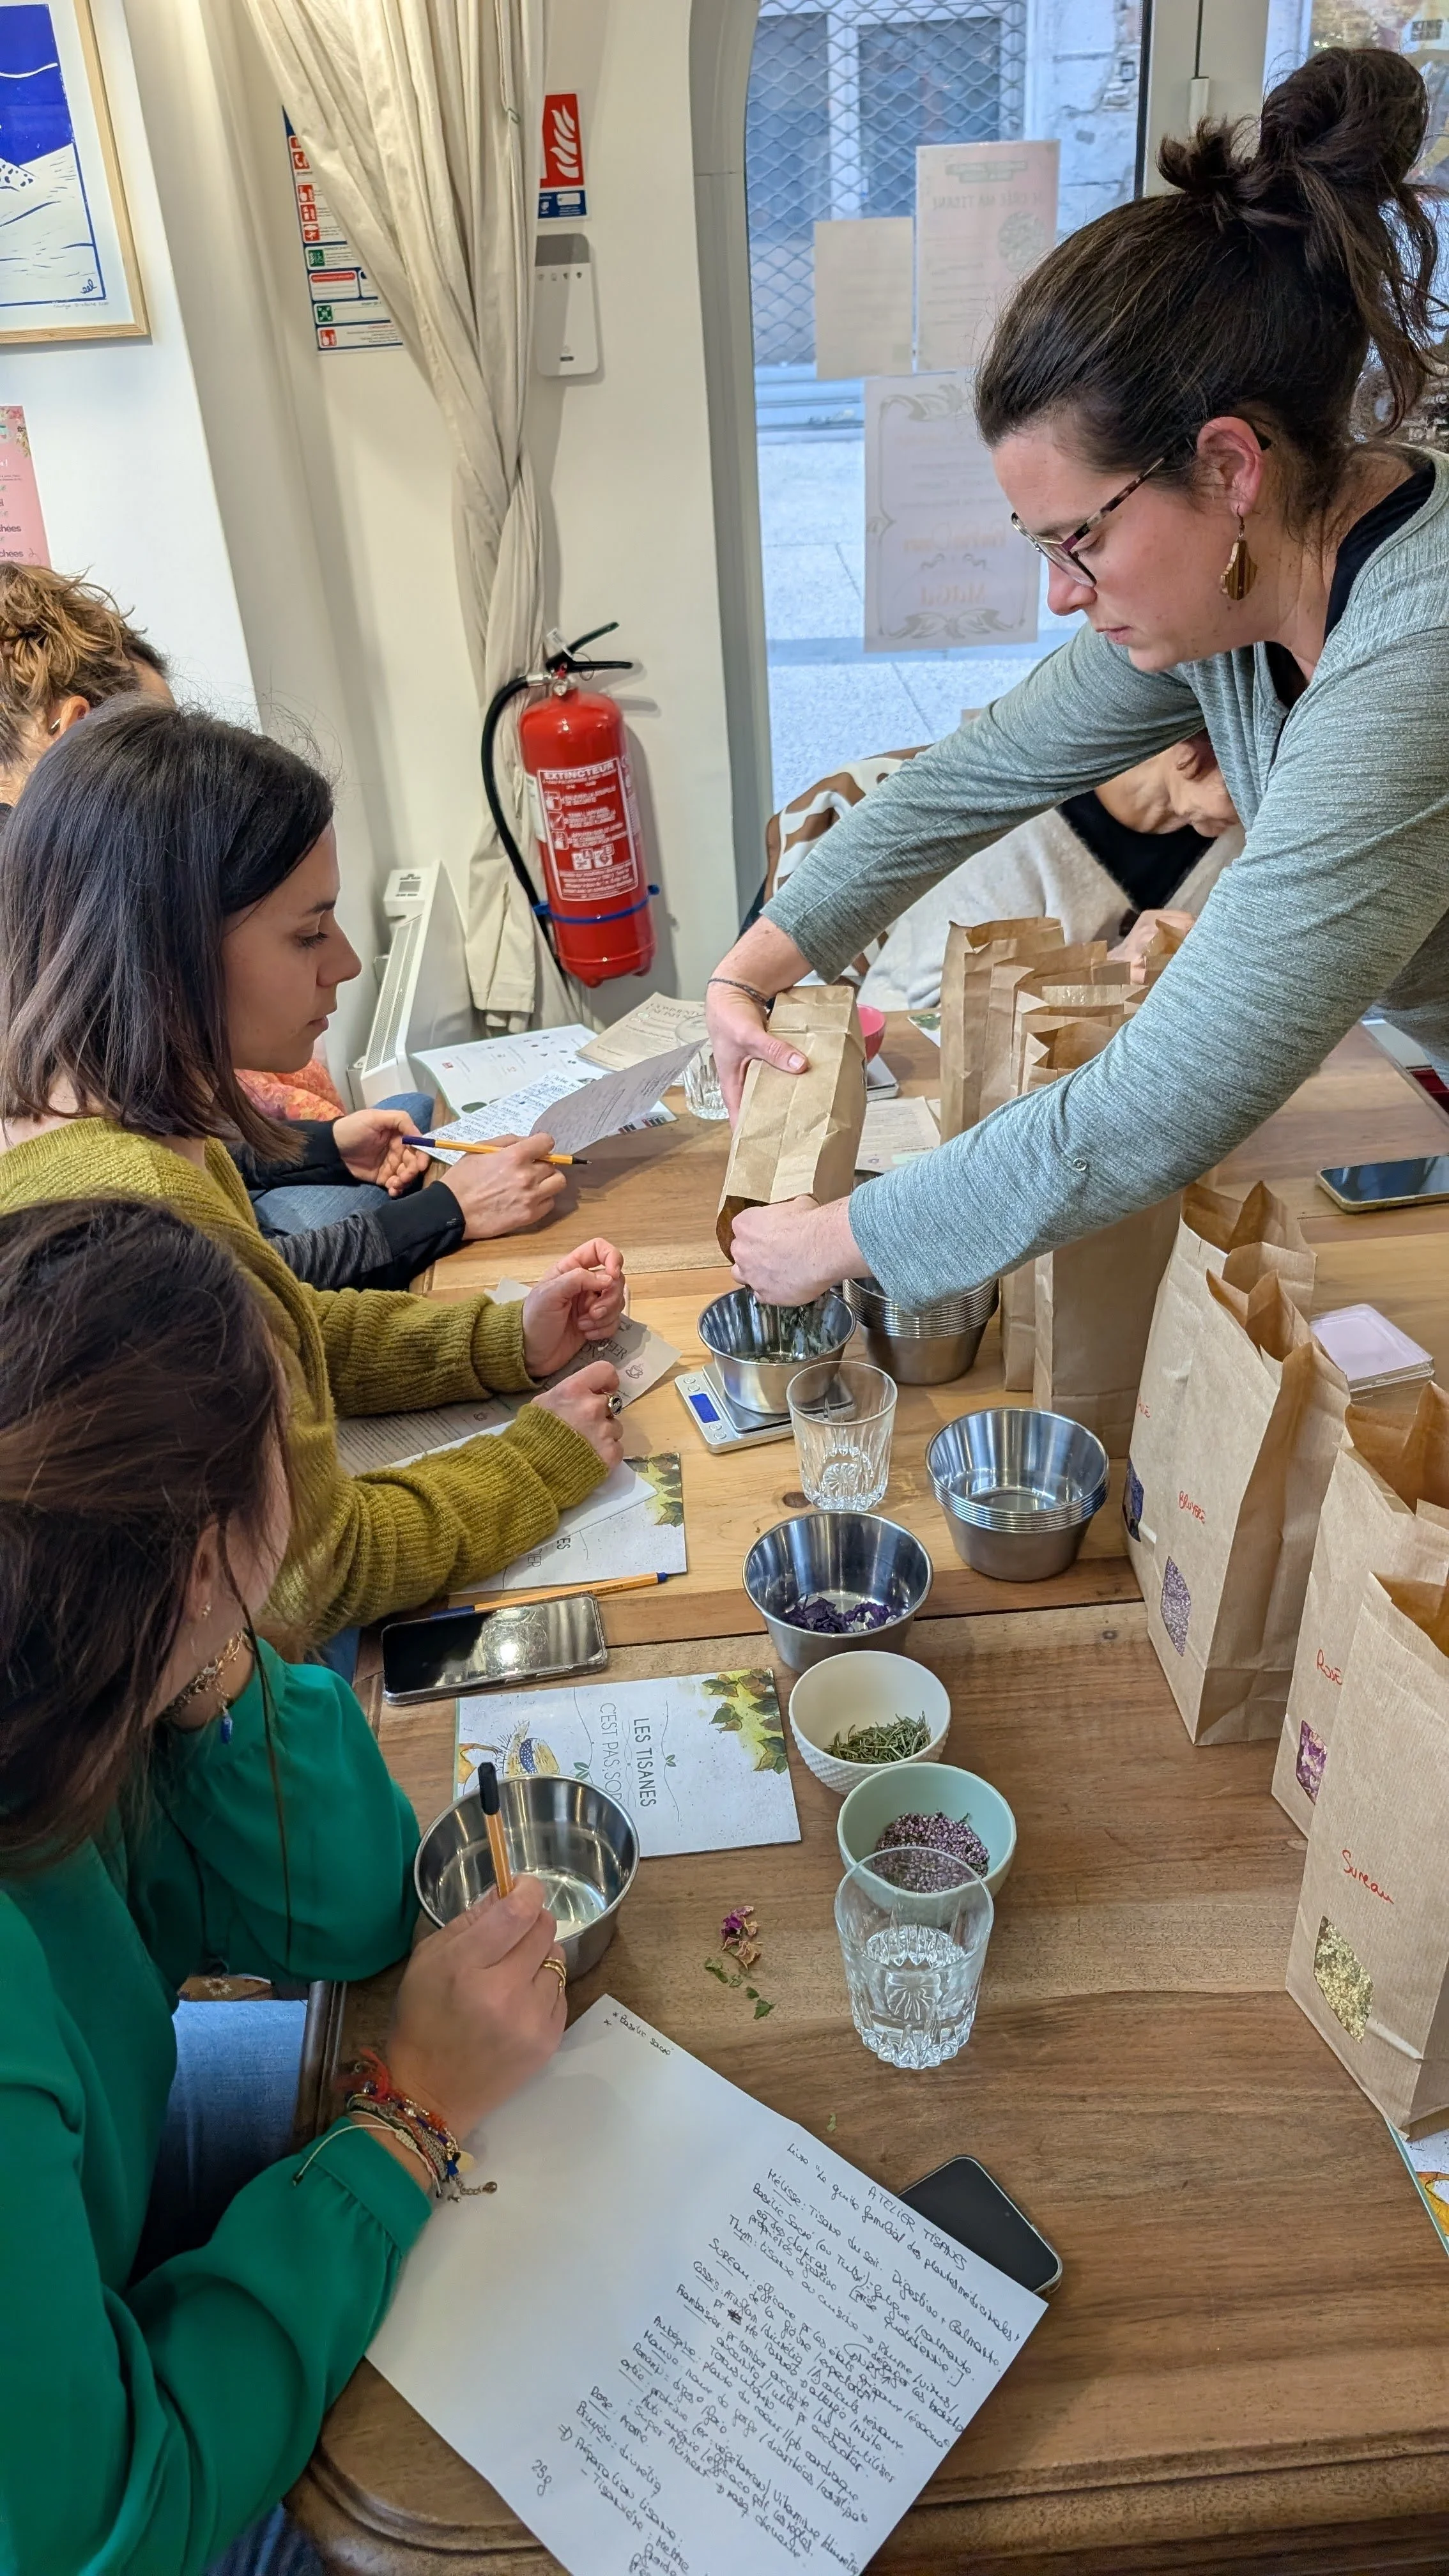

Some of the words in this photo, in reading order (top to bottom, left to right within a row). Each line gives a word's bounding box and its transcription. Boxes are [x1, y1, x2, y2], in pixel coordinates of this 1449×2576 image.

[544, 762, 614, 780] EXTINCTEUR
[599, 1703, 618, 1736] C'EST
[633, 1718, 652, 1743] LES
[602, 1742, 620, 1768] PAS
[636, 1747, 657, 1807] TISANES
